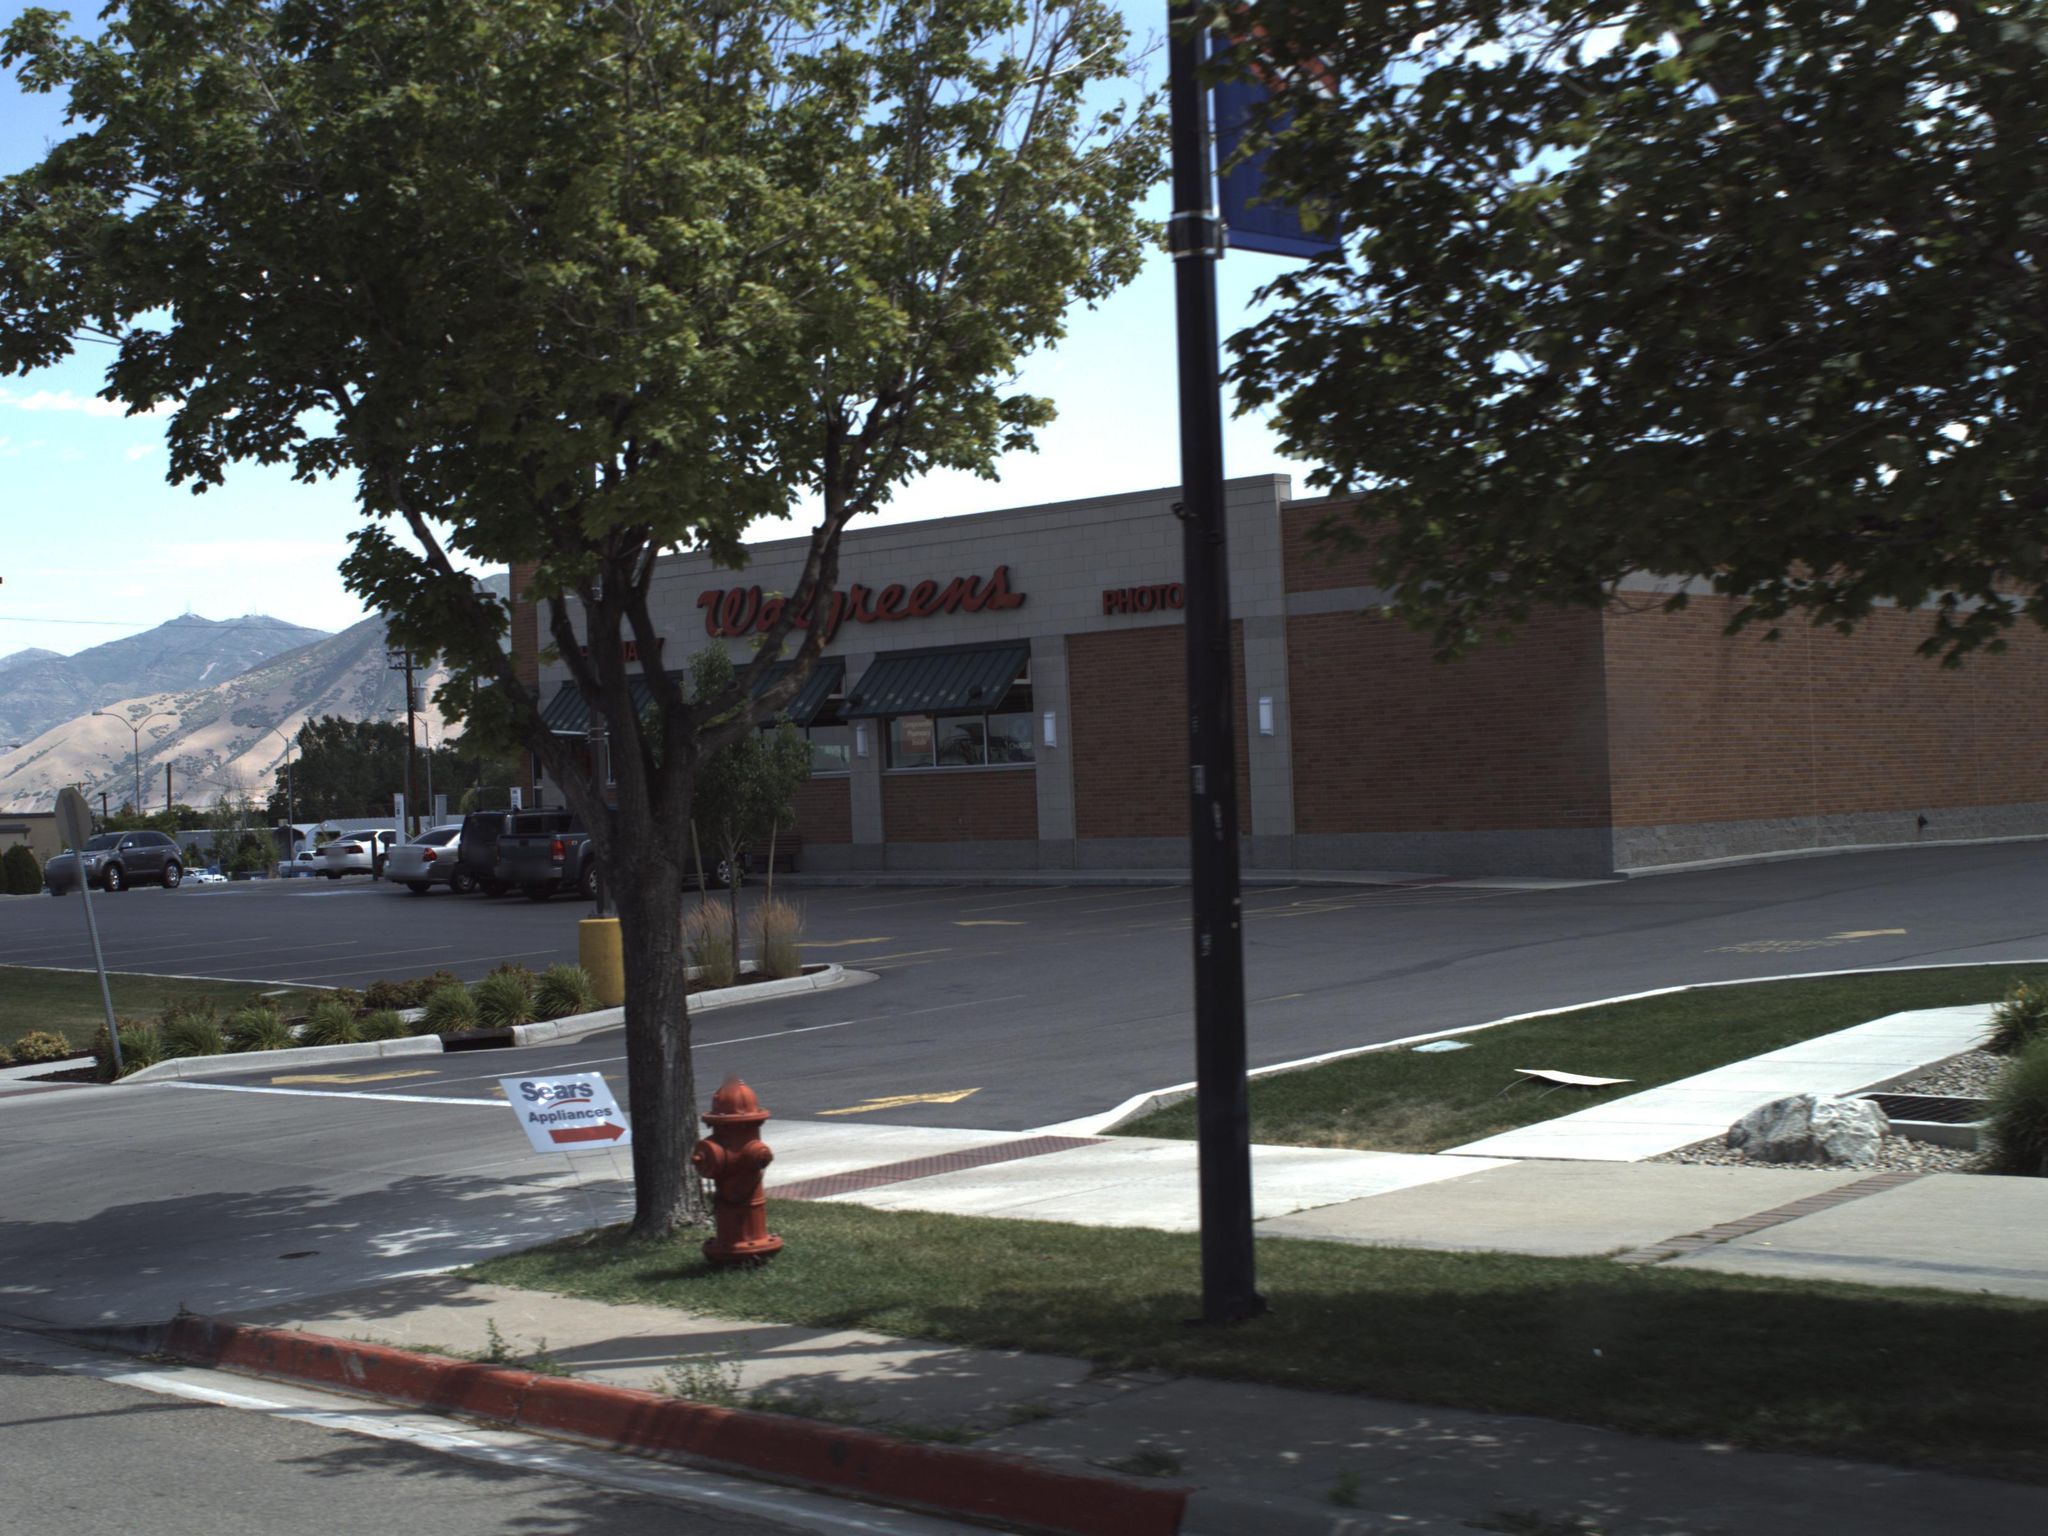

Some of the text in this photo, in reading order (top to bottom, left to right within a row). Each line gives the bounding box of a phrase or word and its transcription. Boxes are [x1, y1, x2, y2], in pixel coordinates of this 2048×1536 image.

[1103, 582, 1185, 616] PHOTO
[520, 1081, 594, 1101] Sears
[528, 1107, 613, 1124] Appliances
